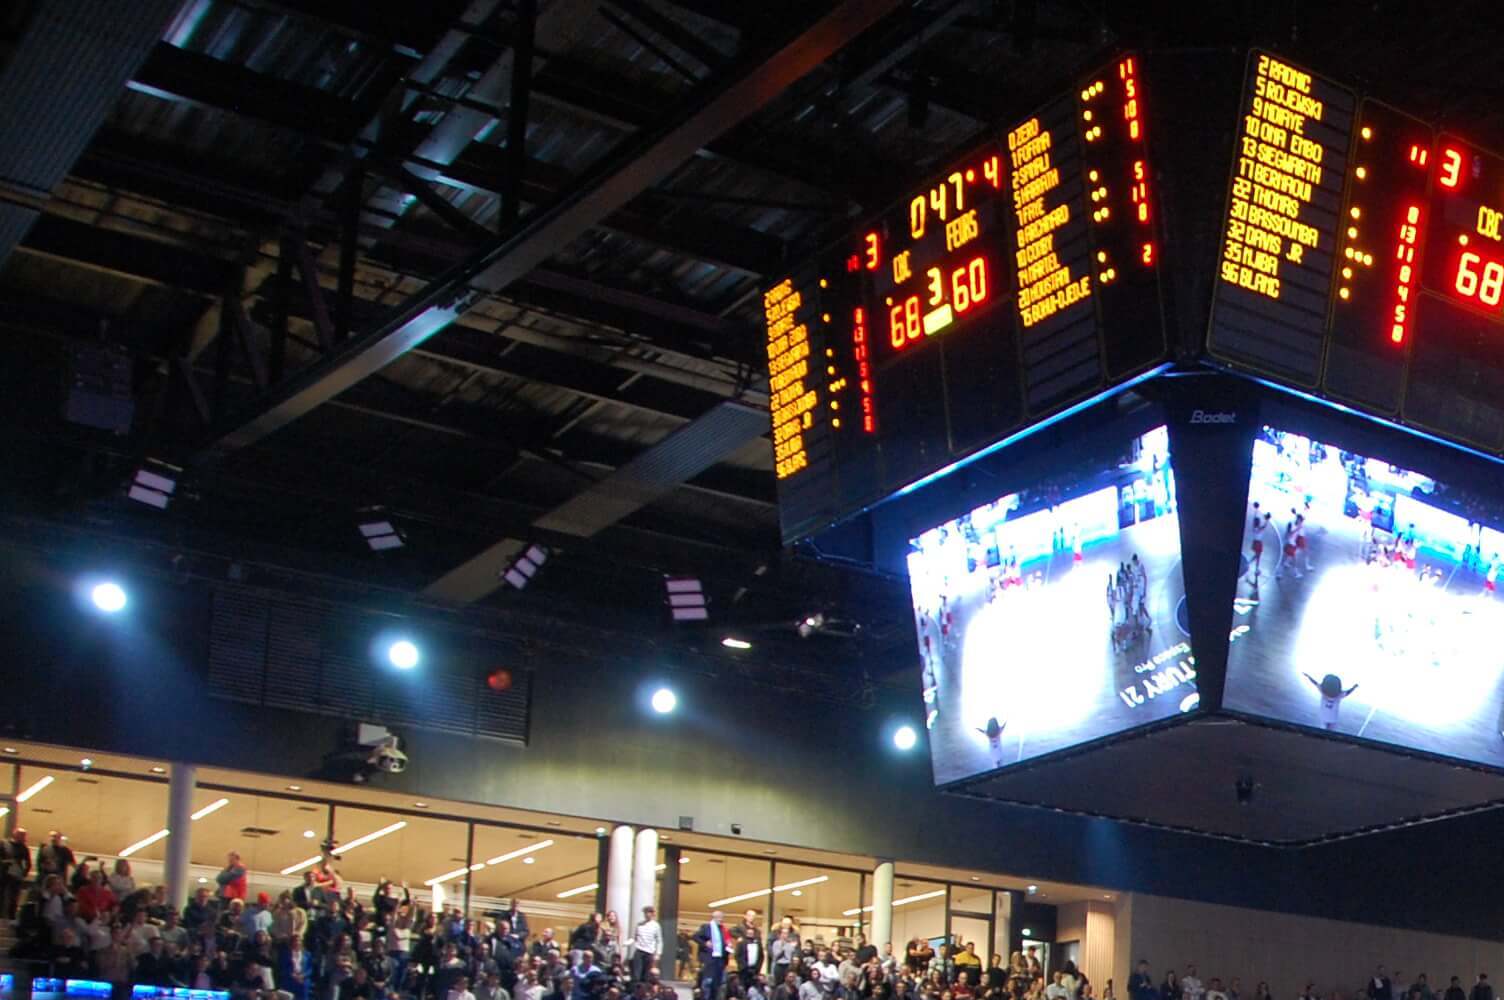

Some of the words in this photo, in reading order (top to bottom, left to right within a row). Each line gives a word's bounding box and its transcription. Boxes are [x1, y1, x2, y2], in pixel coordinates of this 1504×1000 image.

[1119, 58, 1133, 80] 11
[1258, 56, 1269, 75] 2
[1125, 79, 1135, 98] 5
[1256, 76, 1266, 98] 5
[1266, 81, 1322, 120] ROJEWSKI
[1253, 97, 1263, 116] 9
[1246, 115, 1260, 137] 10
[1134, 161, 1143, 181] 5
[1240, 158, 1255, 179] 17
[1243, 137, 1257, 157] 13
[1257, 143, 1321, 184] SIEGWARTH
[1440, 149, 1461, 187] 3
[1132, 183, 1146, 203] 11
[1233, 177, 1251, 200] 22
[1253, 184, 1299, 218] THOMAS
[866, 233, 878, 269] 3
[983, 156, 998, 187] 4
[1230, 198, 1248, 220] 30
[946, 210, 978, 252] FEURS
[1400, 225, 1416, 243] 13
[1476, 205, 1504, 241] CBC
[1227, 219, 1245, 241] 32
[1245, 226, 1281, 254] DAVIS
[1143, 244, 1151, 264] 2
[1224, 240, 1242, 262] 35
[1396, 245, 1413, 263] 11
[1222, 261, 1239, 283] 96
[1239, 267, 1280, 298] BLANC
[890, 297, 921, 348] 68
[926, 266, 943, 305] 3
[951, 257, 987, 313] 60
[1397, 286, 1409, 302] 4
[1395, 305, 1405, 322] 5
[1189, 409, 1237, 424] Bodet
[1120, 686, 1145, 709] 21
